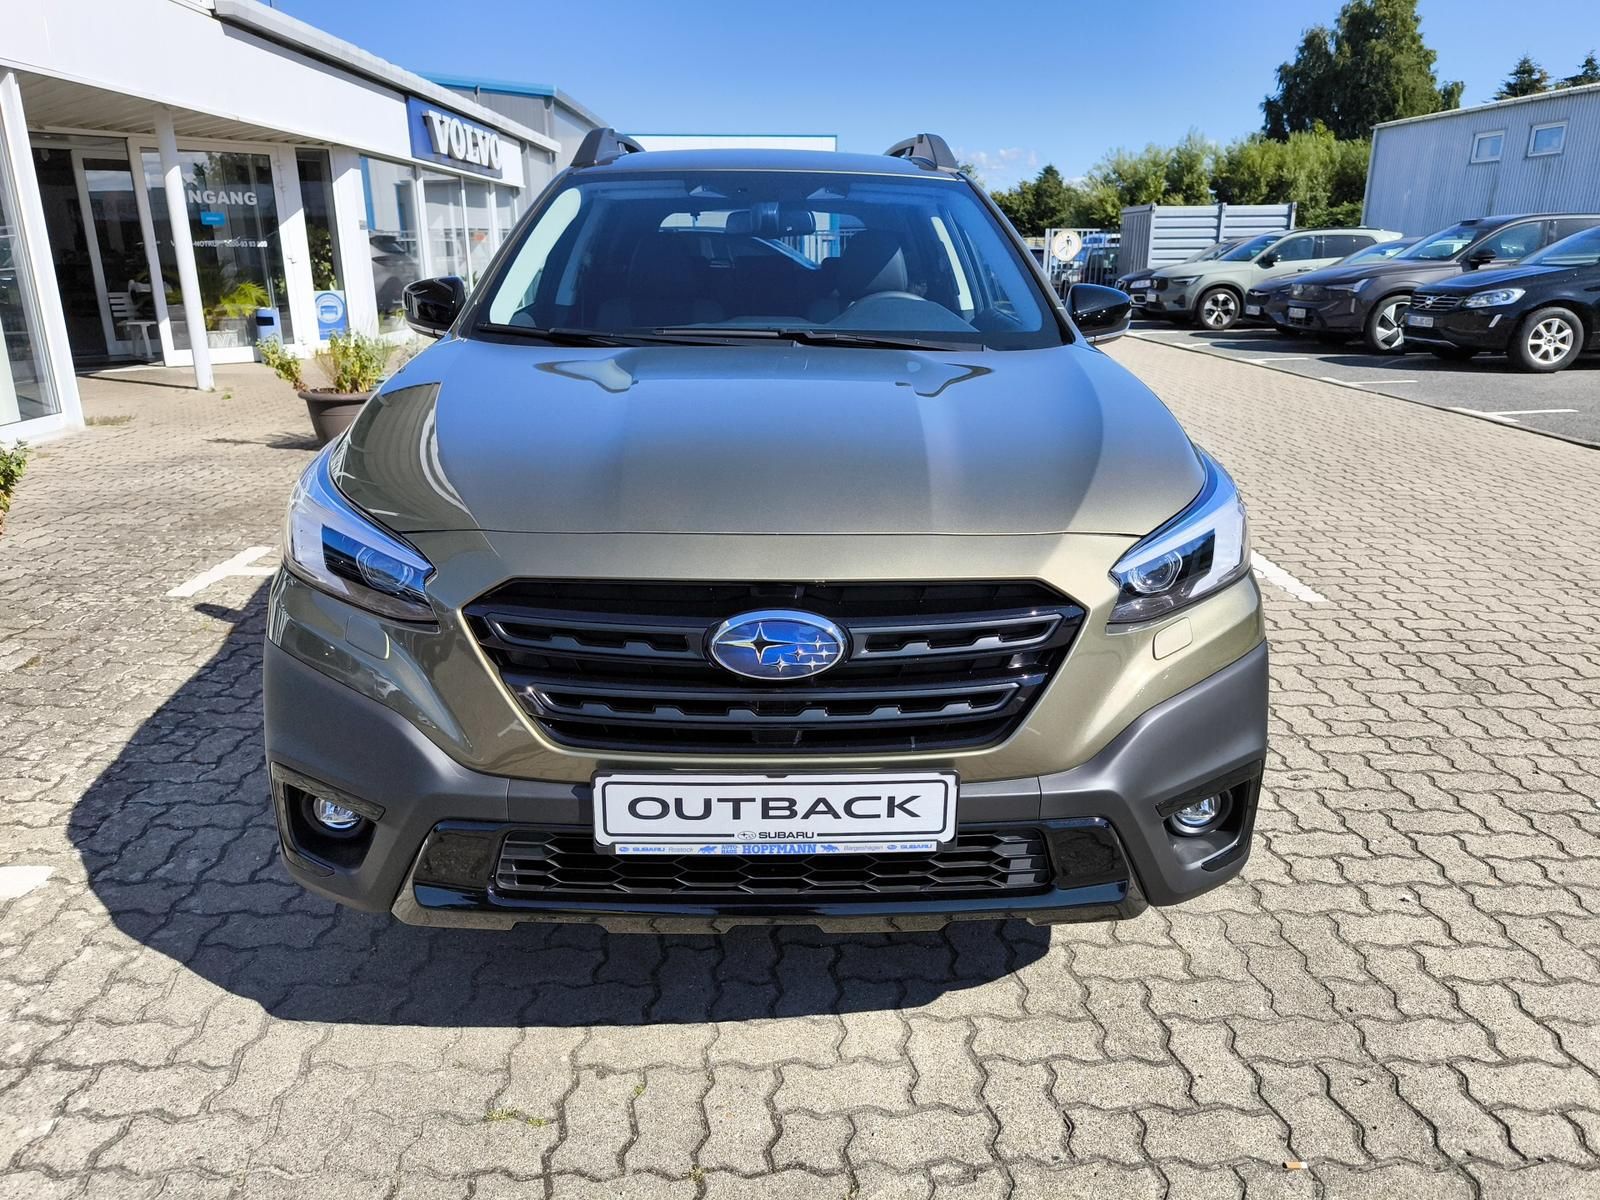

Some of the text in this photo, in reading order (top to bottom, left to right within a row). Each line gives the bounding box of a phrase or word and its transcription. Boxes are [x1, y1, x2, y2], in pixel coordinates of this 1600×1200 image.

[425, 110, 502, 170] VOLVO
[187, 189, 257, 206] NGANG
[627, 795, 921, 820] OUTBACK
[758, 831, 814, 839] SUBARU
